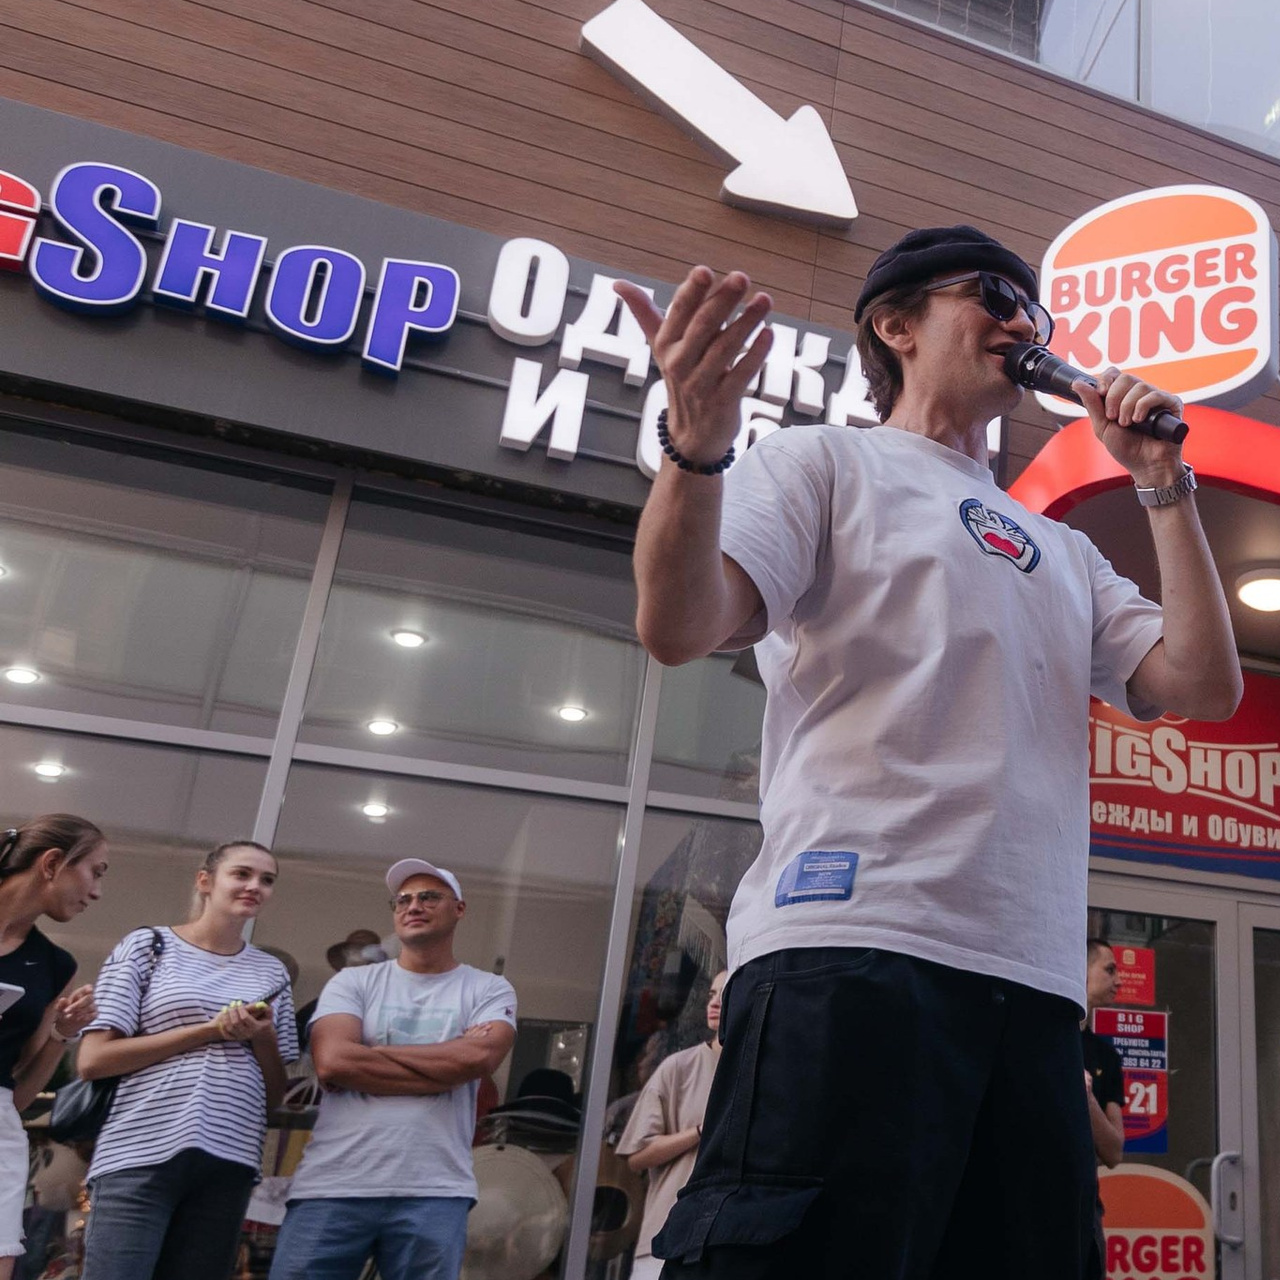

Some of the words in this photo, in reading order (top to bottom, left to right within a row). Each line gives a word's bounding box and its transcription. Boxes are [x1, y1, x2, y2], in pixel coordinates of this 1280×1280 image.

[1051, 243, 1258, 313] BURGER
[1049, 286, 1258, 369] KING
[1182, 815, 1198, 837] и
[1117, 1023, 1144, 1034] SHOP
[1106, 1235, 1206, 1273] RGER
